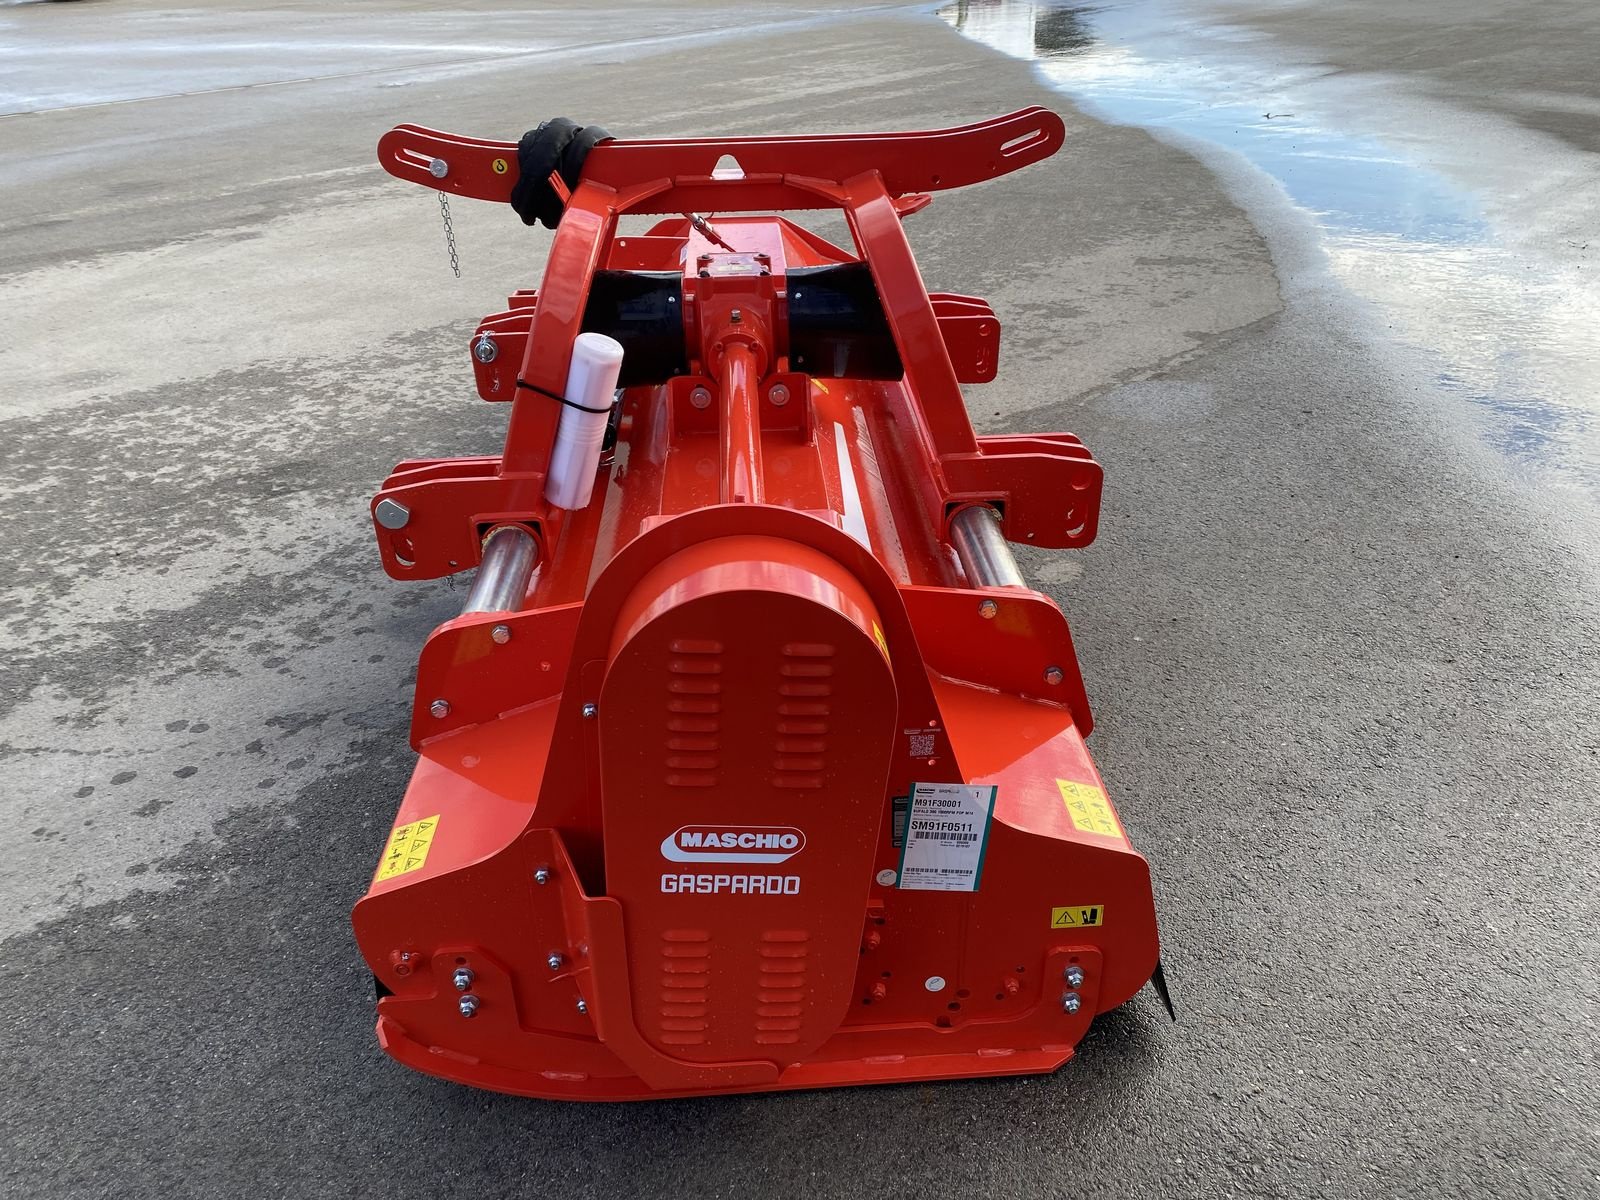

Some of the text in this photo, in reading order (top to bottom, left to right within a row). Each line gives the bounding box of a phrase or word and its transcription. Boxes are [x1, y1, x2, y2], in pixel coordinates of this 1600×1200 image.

[914, 799, 962, 808] M91F30001
[911, 820, 973, 832] SM91F0511
[680, 832, 799, 849] MASCHIO
[660, 874, 801, 895] GASPARDO
